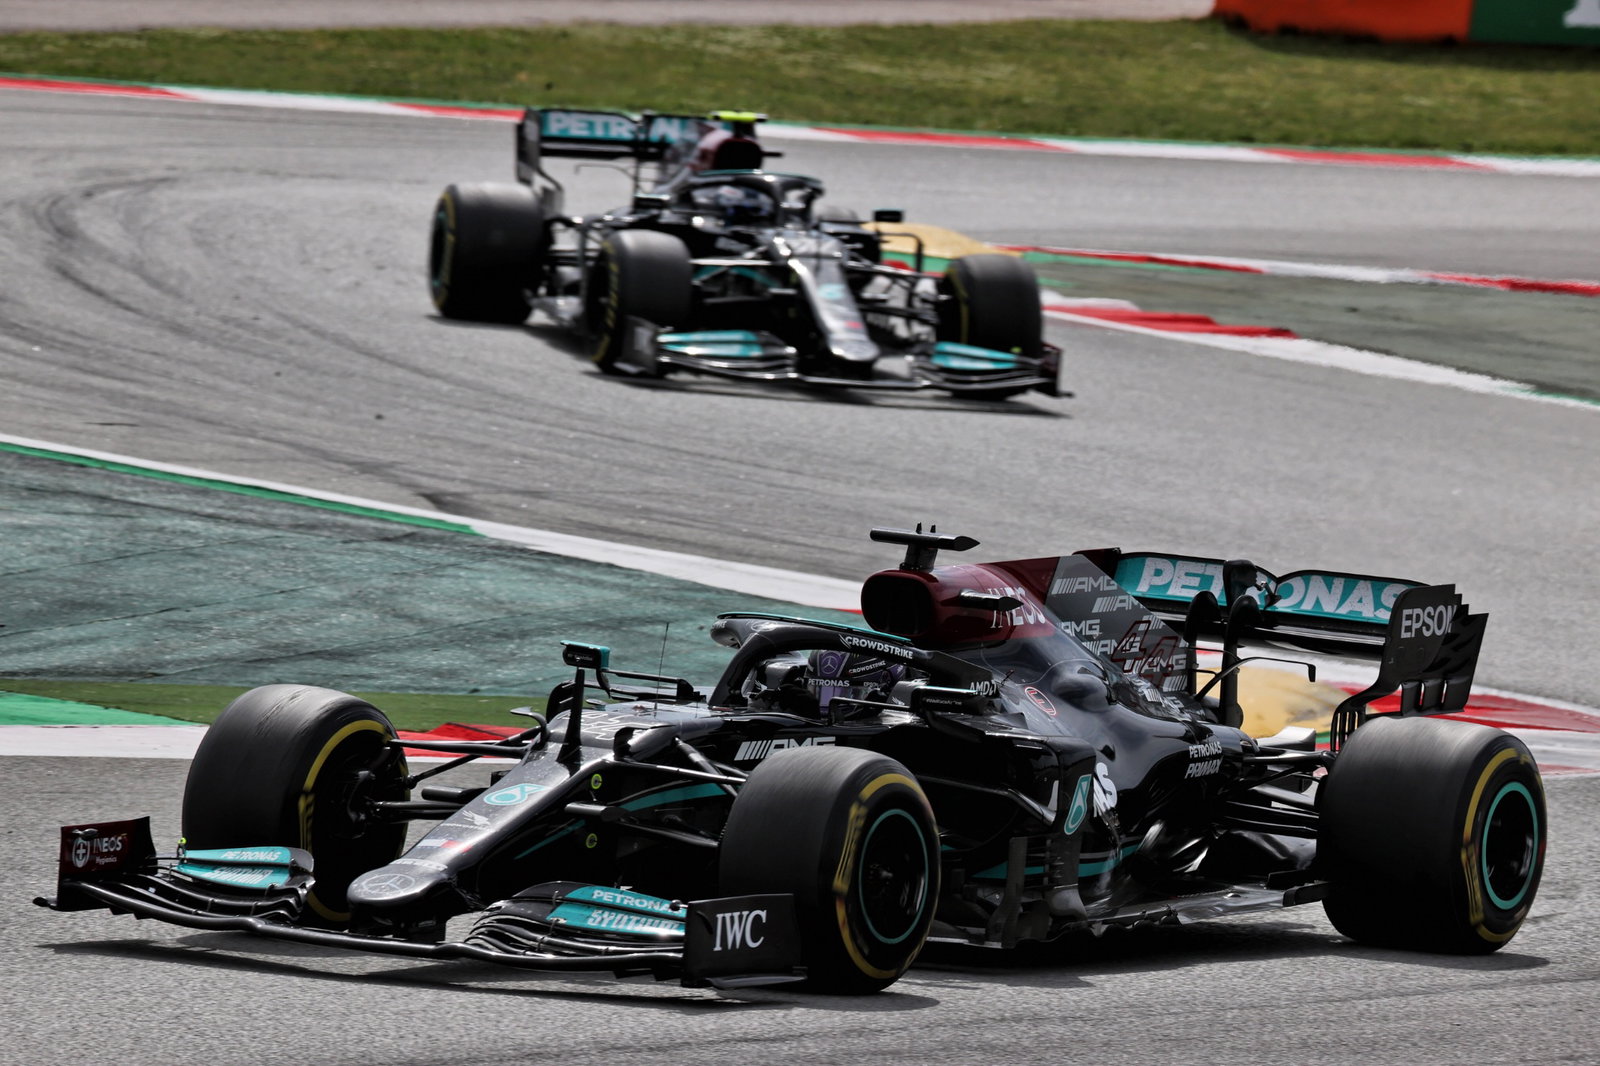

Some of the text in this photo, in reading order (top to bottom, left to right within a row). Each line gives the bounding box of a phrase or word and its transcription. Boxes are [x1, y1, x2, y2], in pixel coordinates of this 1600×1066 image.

[1072, 576, 1118, 593] AMG
[1114, 595, 1146, 611] AM
[1401, 604, 1457, 639] EPSON
[845, 636, 914, 660] CROWDSTRIKE
[808, 678, 850, 688] PETRONAS
[1188, 741, 1223, 759] PETRONAS
[93, 836, 123, 854] INEOS
[220, 851, 282, 861] PETRONAS
[713, 909, 767, 951] IWC
